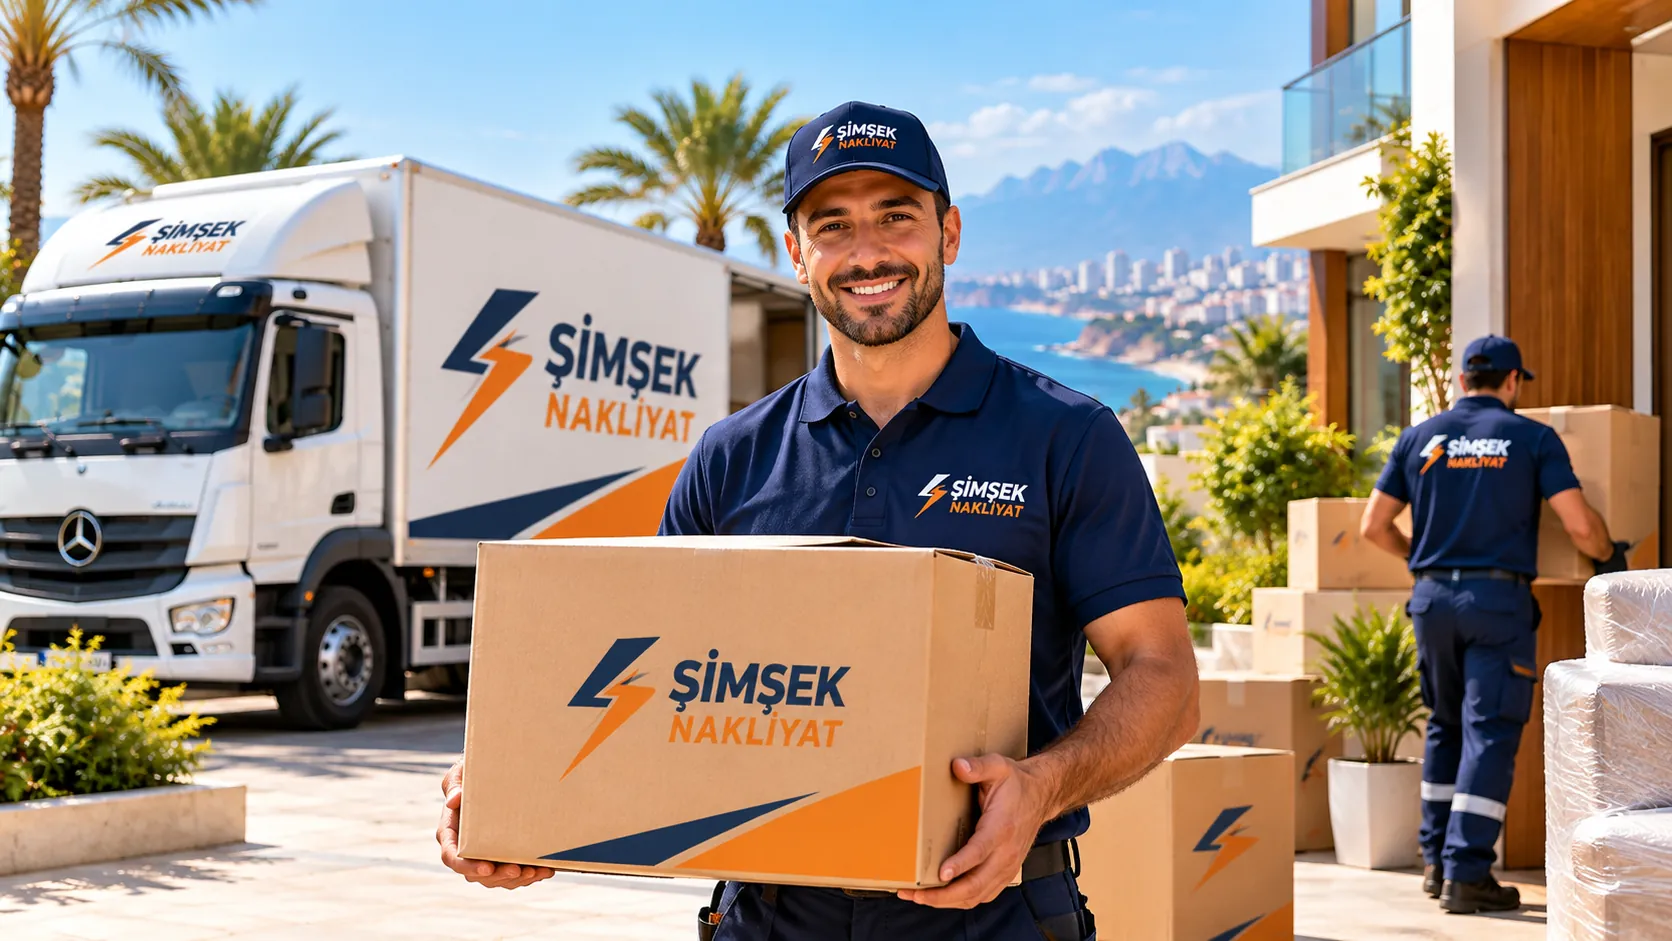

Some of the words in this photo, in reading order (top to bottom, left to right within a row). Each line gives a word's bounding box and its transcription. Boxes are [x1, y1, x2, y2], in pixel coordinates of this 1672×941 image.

[837, 121, 897, 141] ŞİMŞEK
[151, 220, 247, 244] ŞİMŞEK
[544, 313, 702, 399] ŞİMŞEK
[544, 392, 695, 443] NAKLİYAT
[950, 475, 1028, 503] ŞİMŞEK
[949, 501, 1024, 518] NAKLİYAT
[668, 648, 851, 715] ŞİMŞEK
[668, 711, 844, 748] NAKLİYAT
